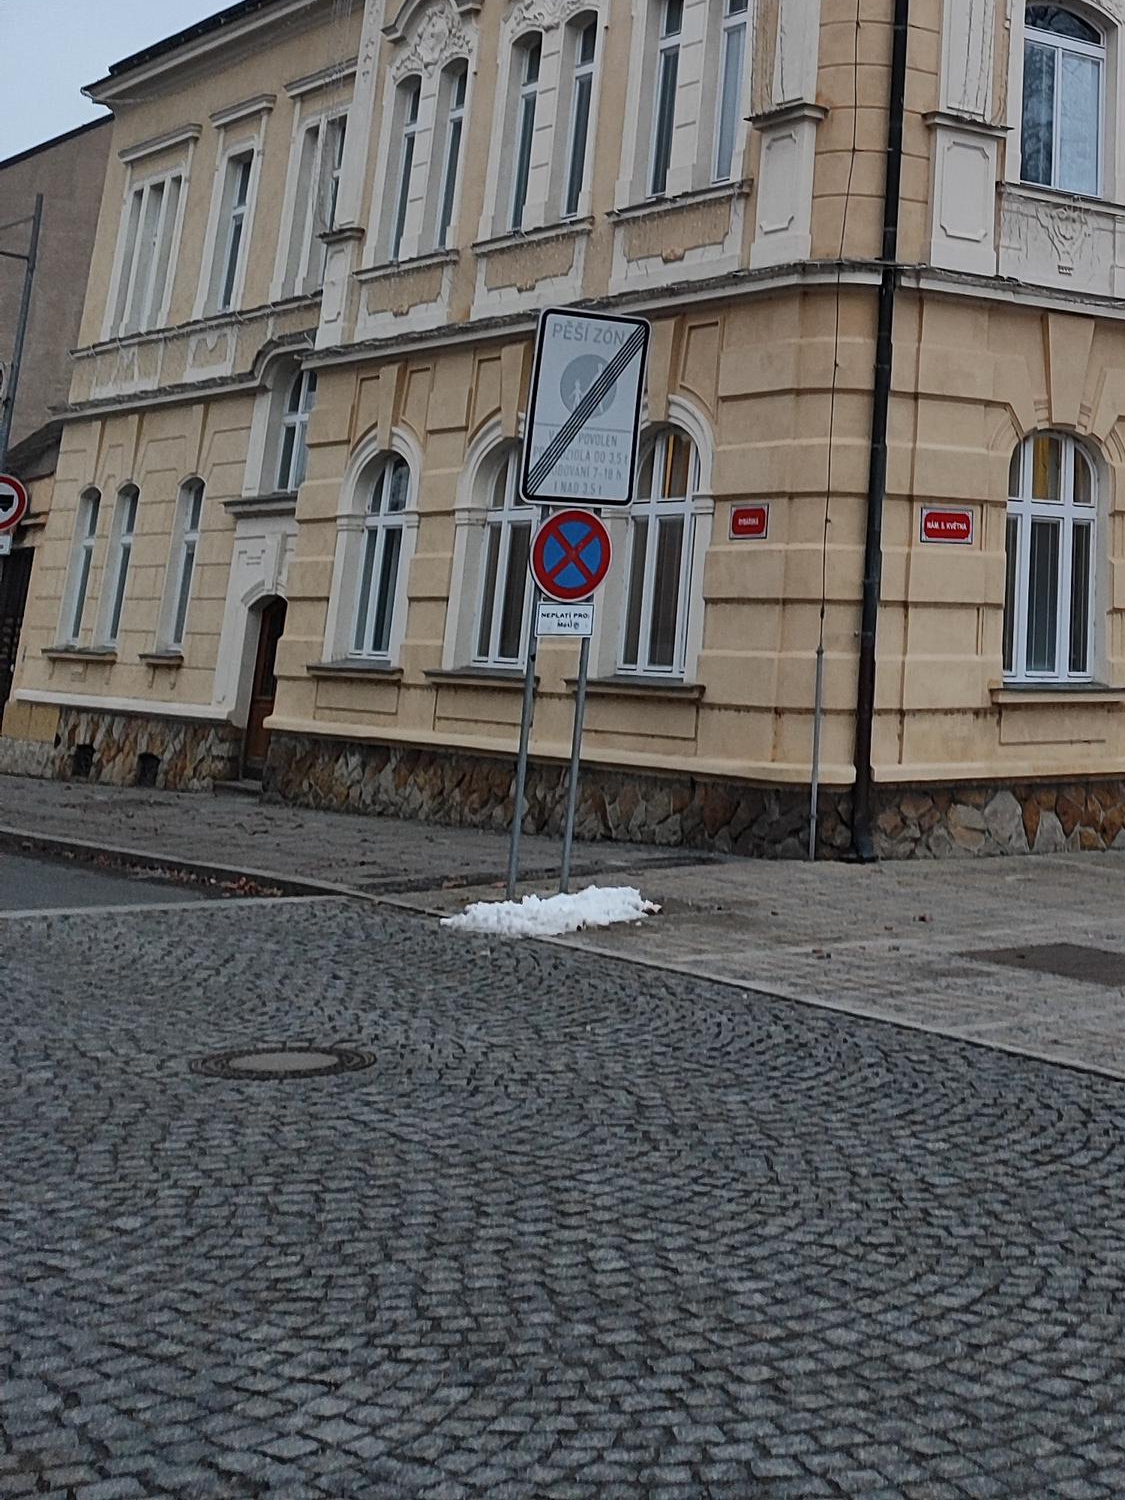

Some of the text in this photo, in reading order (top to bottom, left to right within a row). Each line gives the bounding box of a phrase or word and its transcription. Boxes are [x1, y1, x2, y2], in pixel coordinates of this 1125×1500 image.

[552, 320, 630, 346] PĚŠÍ ZÓN
[541, 611, 572, 619] NEPLATÍ
